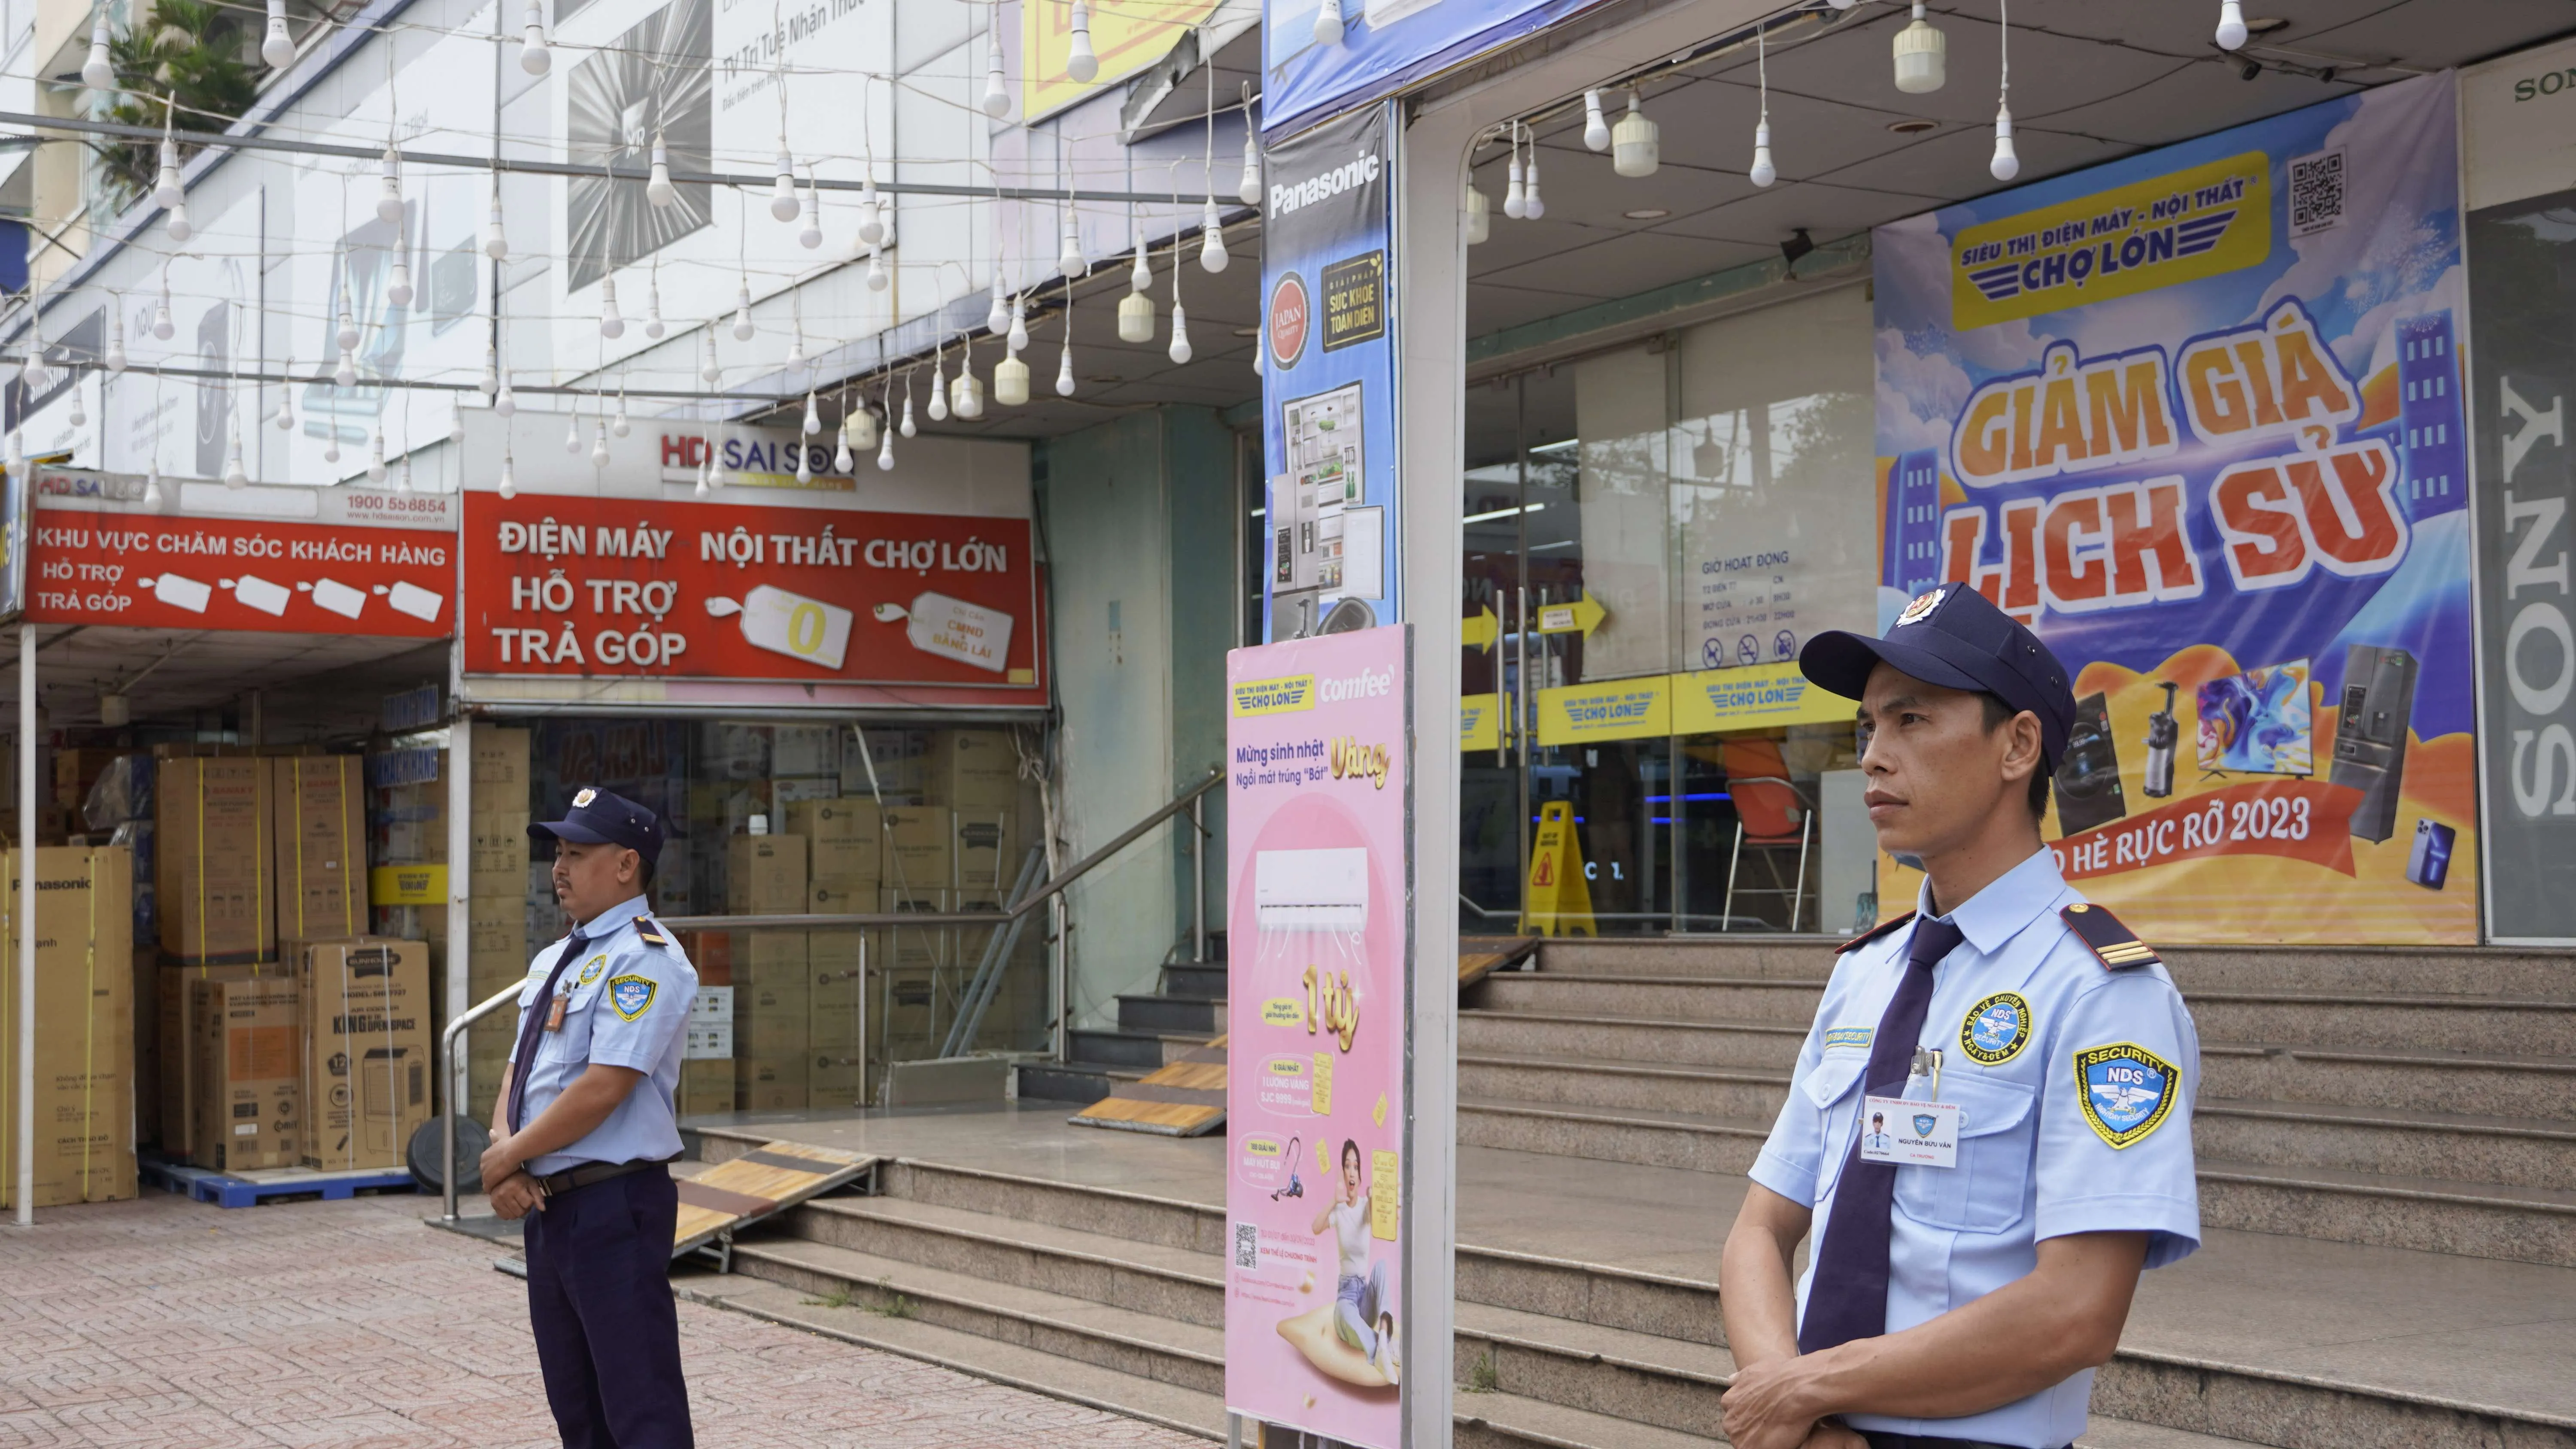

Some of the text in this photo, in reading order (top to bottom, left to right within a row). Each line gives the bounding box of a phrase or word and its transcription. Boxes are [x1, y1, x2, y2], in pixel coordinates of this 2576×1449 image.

[723, 3, 826, 84] TV Trí Tuệ Nhận
[1270, 150, 1379, 219] Panasonic
[1961, 174, 2245, 266] SIÊU THỊ ĐIỆN MÁY NỘI THẤT
[2021, 225, 2176, 293] CHỢ LỚN
[1330, 281, 1374, 313] SỨC KHỎE
[1275, 304, 1302, 330] JAPAN
[1331, 304, 1375, 333] TOÀN DIỆN
[1958, 313, 2351, 477] GIẢM GIÁ
[662, 435, 712, 466] HD
[39, 476, 71, 494] HD
[347, 495, 447, 514] 1900 558854
[1947, 425, 2398, 627] LỊCH SỬ
[37, 527, 89, 549] KHU
[97, 531, 149, 557] VỰC
[156, 530, 227, 555] CHĂM
[233, 531, 283, 559] SÓC
[291, 537, 372, 563] KHÁCH
[380, 538, 446, 567] HÀNG
[499, 517, 1007, 576] ĐIỆN MÁY NỘI THẤT CHỢ LỚN
[43, 557, 124, 585] HỖ TRỢ
[1702, 557, 1722, 574] GIỜ
[38, 589, 132, 612] TRẢ GÓP
[512, 569, 678, 621] HỖ TRỢ
[2500, 375, 2576, 818] SONY
[788, 602, 826, 655] 0
[948, 619, 984, 638] CMND
[492, 622, 687, 667] TRẢ GÓP
[1252, 688, 1290, 710] CHỢ LỚN
[1236, 738, 1324, 767] Mừng sinh nhật
[1331, 734, 1391, 790] Vàng
[1236, 769, 1258, 789] Ngồi
[1259, 770, 1276, 785] mát
[1279, 768, 1301, 786] trúng
[2073, 832, 2108, 873] HÈ
[2116, 816, 2176, 868] RỰC
[2182, 798, 2225, 850] RỠ
[2230, 796, 2310, 841] 2023
[12, 876, 91, 891] Pnasonic
[615, 976, 650, 986] SECURITY
[1303, 964, 1318, 1034] 1
[333, 1012, 367, 1035] KING
[368, 1018, 416, 1033] OPEN SPACE
[1991, 1008, 2011, 1020] NDS
[1995, 995, 2021, 1007] CHUYÊN
[2018, 1007, 2028, 1037] NGHIỆP
[1974, 1034, 2006, 1048] SECURITY
[2088, 1047, 2165, 1072] SECURITY
[1266, 1076, 1289, 1091] LƯỢNG
[1291, 1076, 1309, 1090] VÀNG
[2107, 1067, 2144, 1085] NDS
[1261, 1091, 1275, 1103] SJC
[1275, 1092, 1292, 1104] 9999
[2122, 1107, 2150, 1122] SECURITY
[1260, 1247, 1270, 1255] XEM
[1304, 1252, 1317, 1264] TRÌNH
